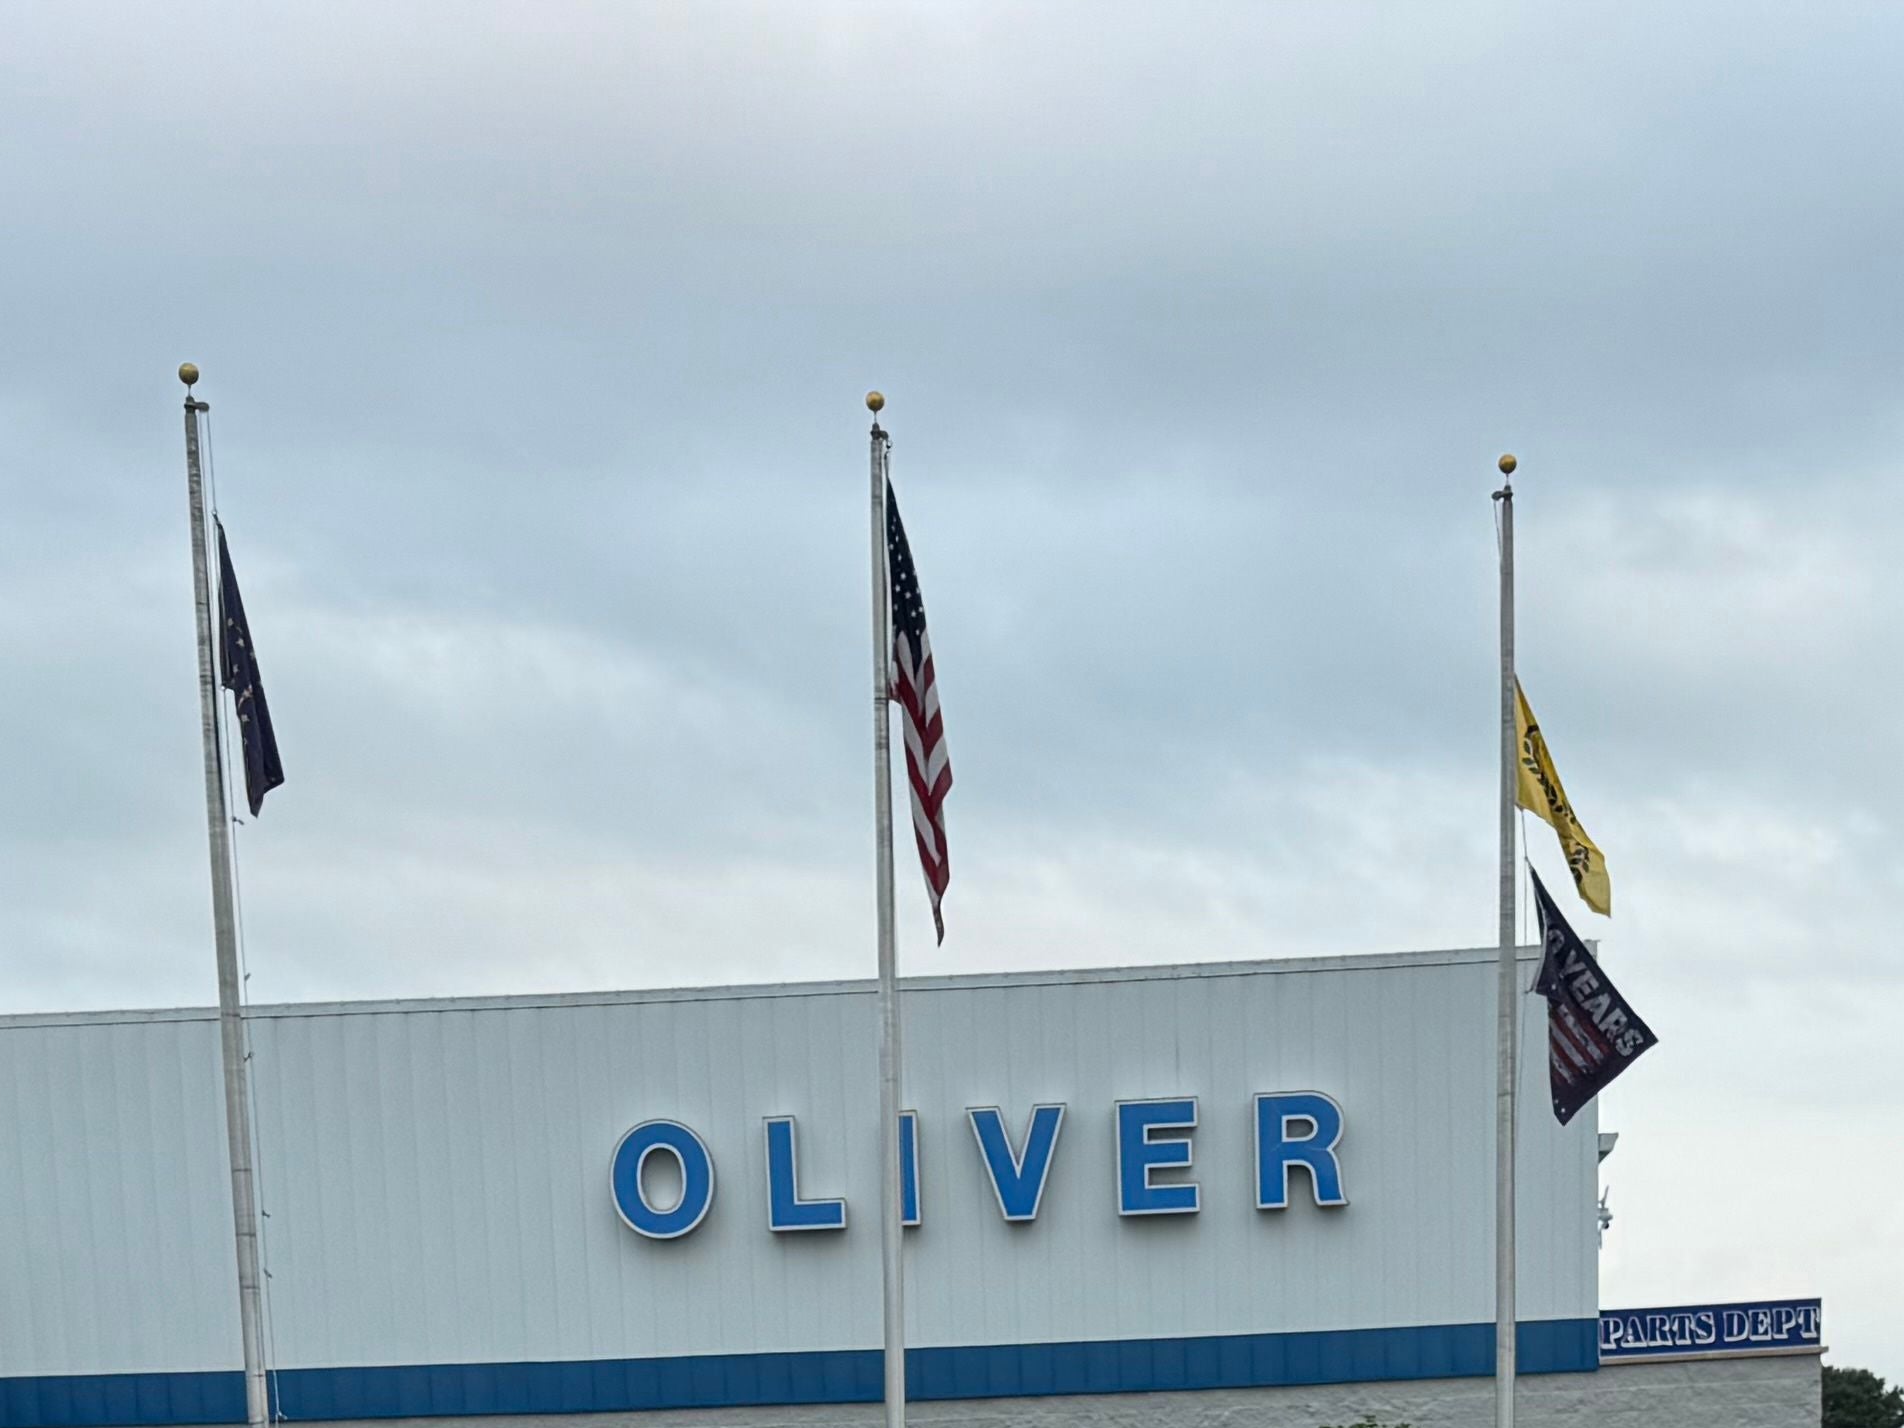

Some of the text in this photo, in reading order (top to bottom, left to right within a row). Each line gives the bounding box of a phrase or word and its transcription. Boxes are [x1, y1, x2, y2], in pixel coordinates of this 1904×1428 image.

[1560, 949, 1644, 1057] YEARS
[609, 1090, 1350, 1240] OLIVER
[1600, 1306, 1820, 1350] PARTS DEPT
